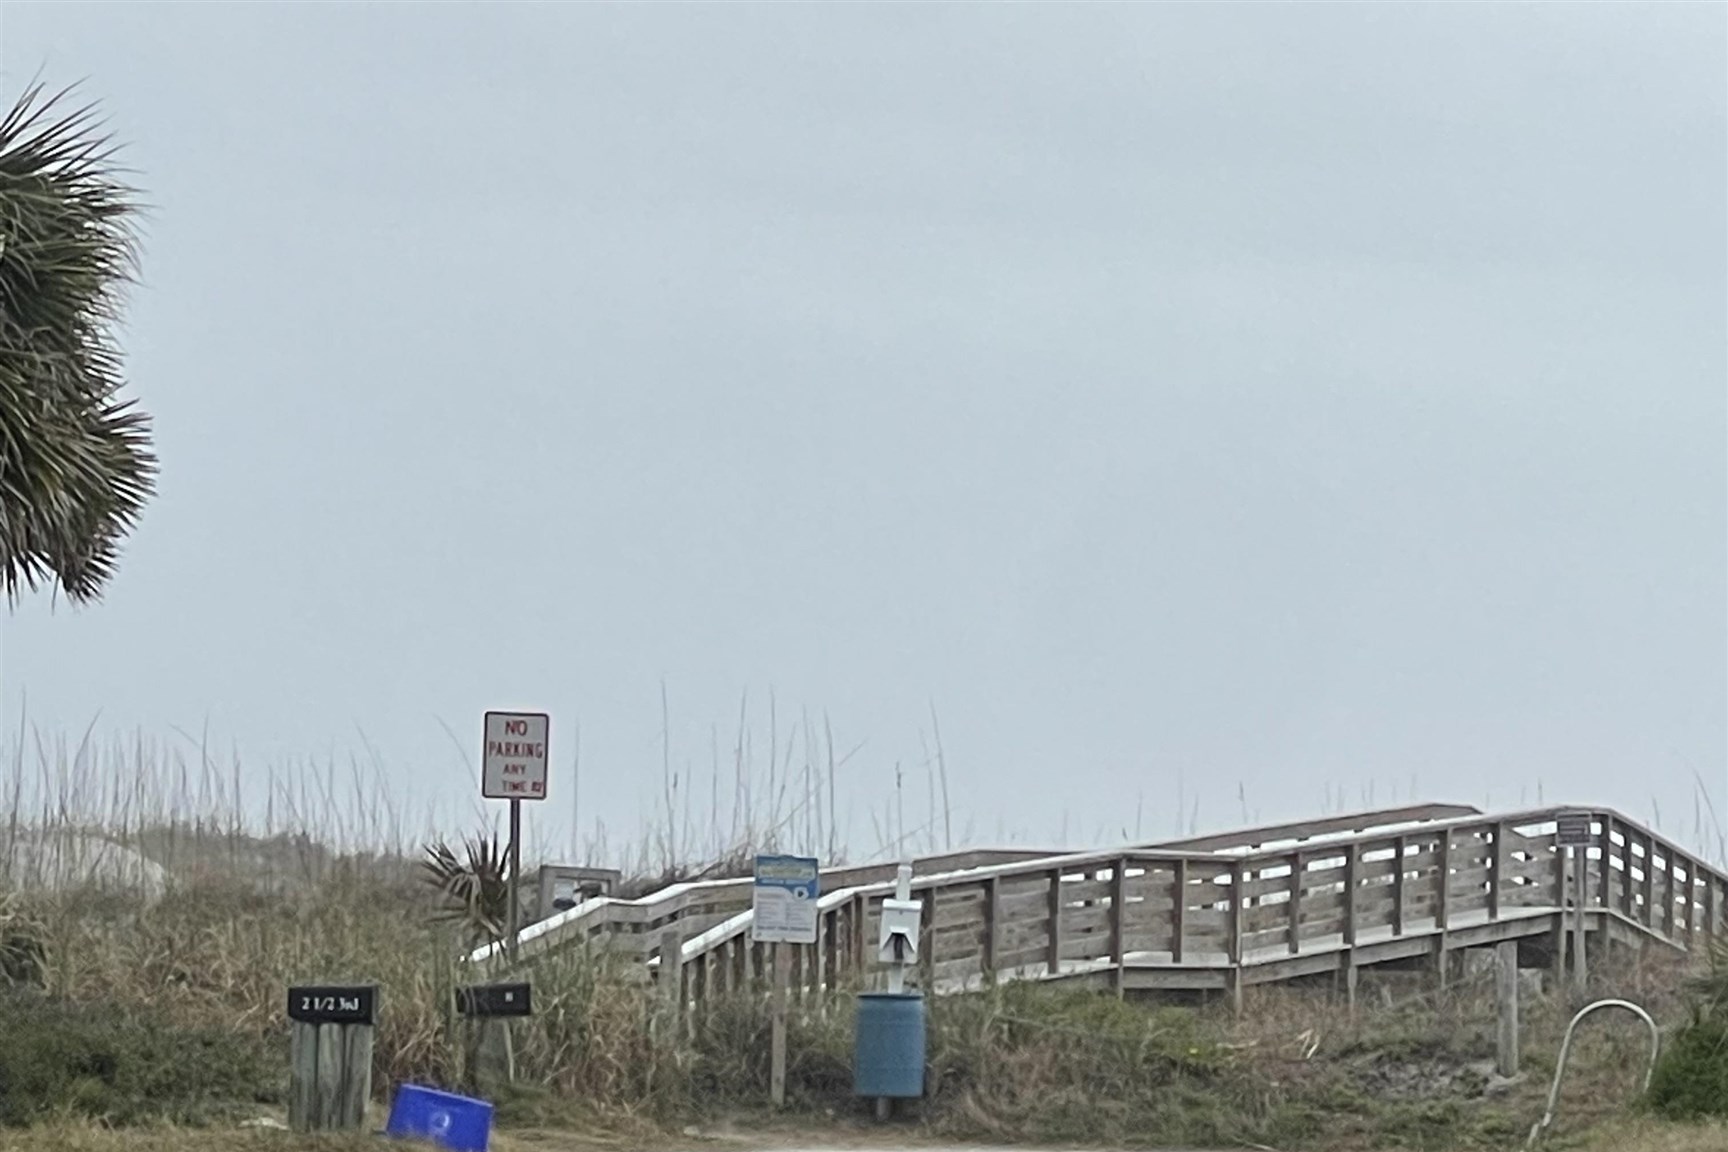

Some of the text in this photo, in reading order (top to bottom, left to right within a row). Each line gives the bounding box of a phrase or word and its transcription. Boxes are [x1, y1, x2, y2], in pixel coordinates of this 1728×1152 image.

[505, 720, 528, 736] NO
[488, 741, 543, 759] PARKING
[503, 764, 527, 775] ANY
[502, 780, 527, 793] TIME
